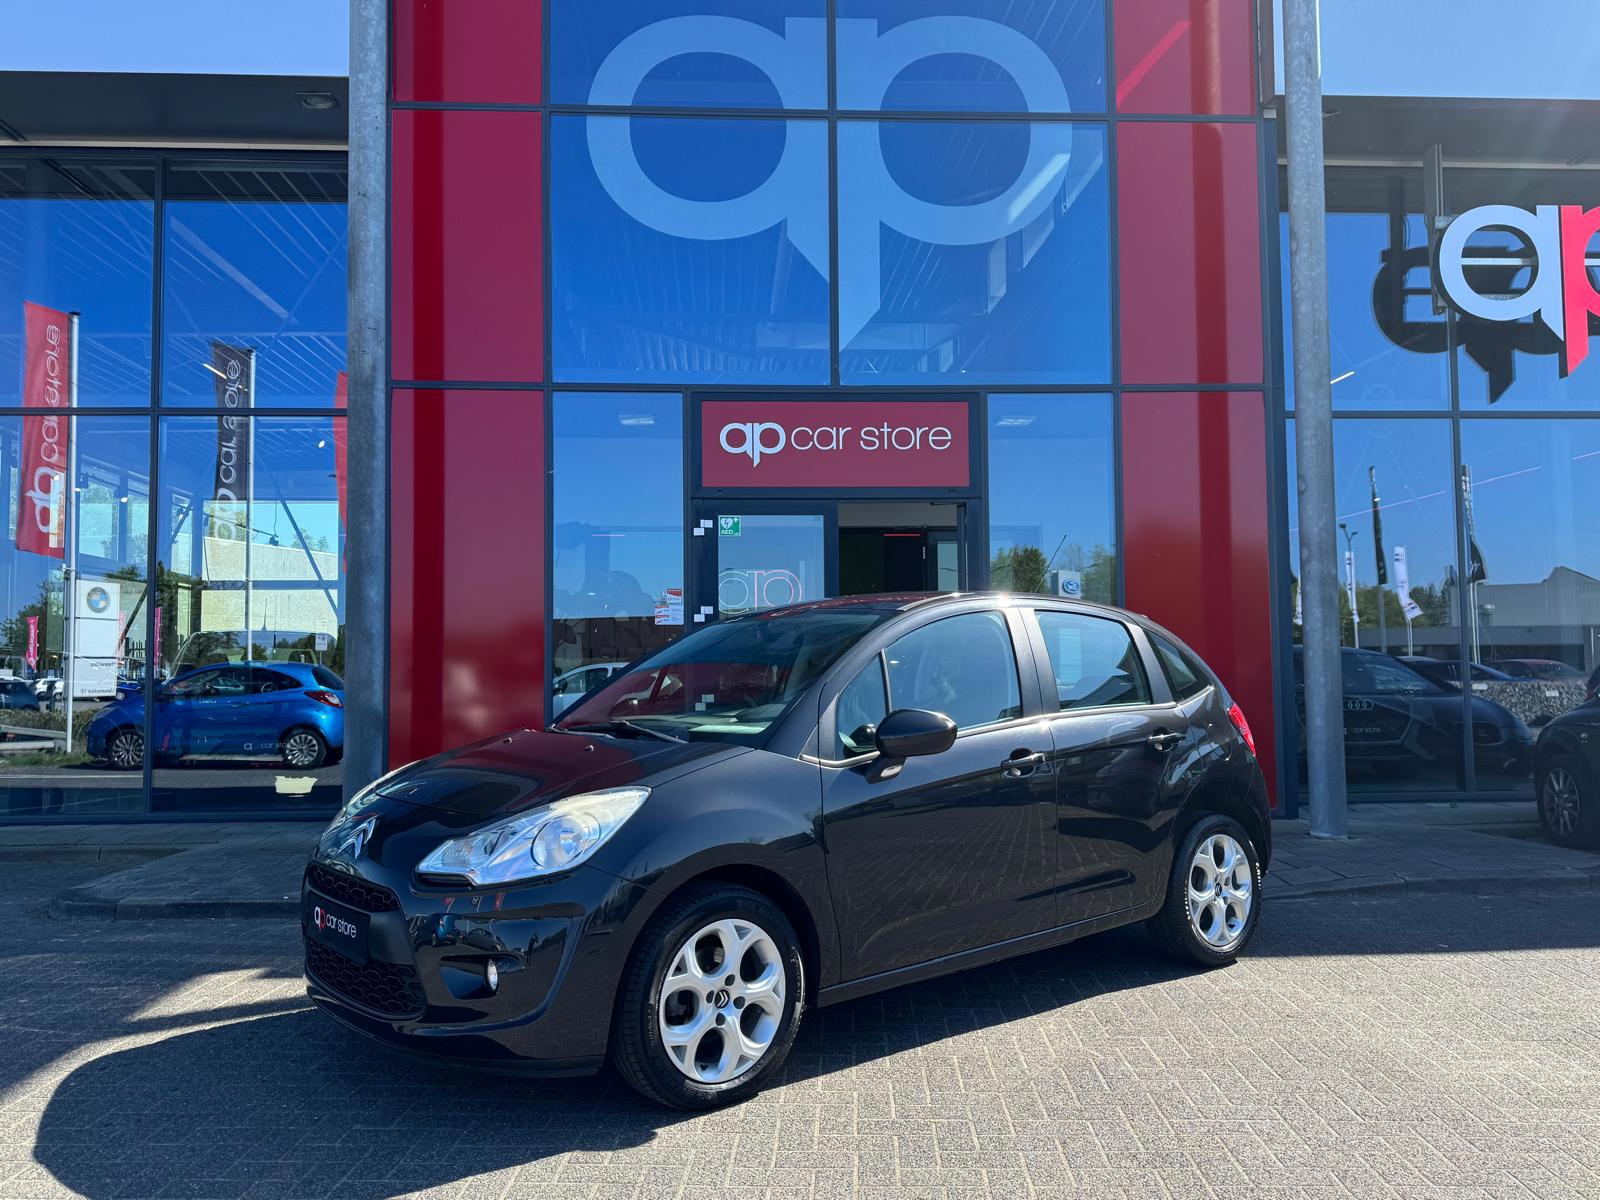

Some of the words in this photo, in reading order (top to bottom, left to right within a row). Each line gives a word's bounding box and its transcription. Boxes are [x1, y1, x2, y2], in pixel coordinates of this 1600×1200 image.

[586, 15, 1072, 352] ap
[719, 421, 786, 468] ap
[791, 426, 852, 451] car
[859, 421, 952, 451] store
[326, 913, 337, 929] car
[337, 918, 357, 938] store
